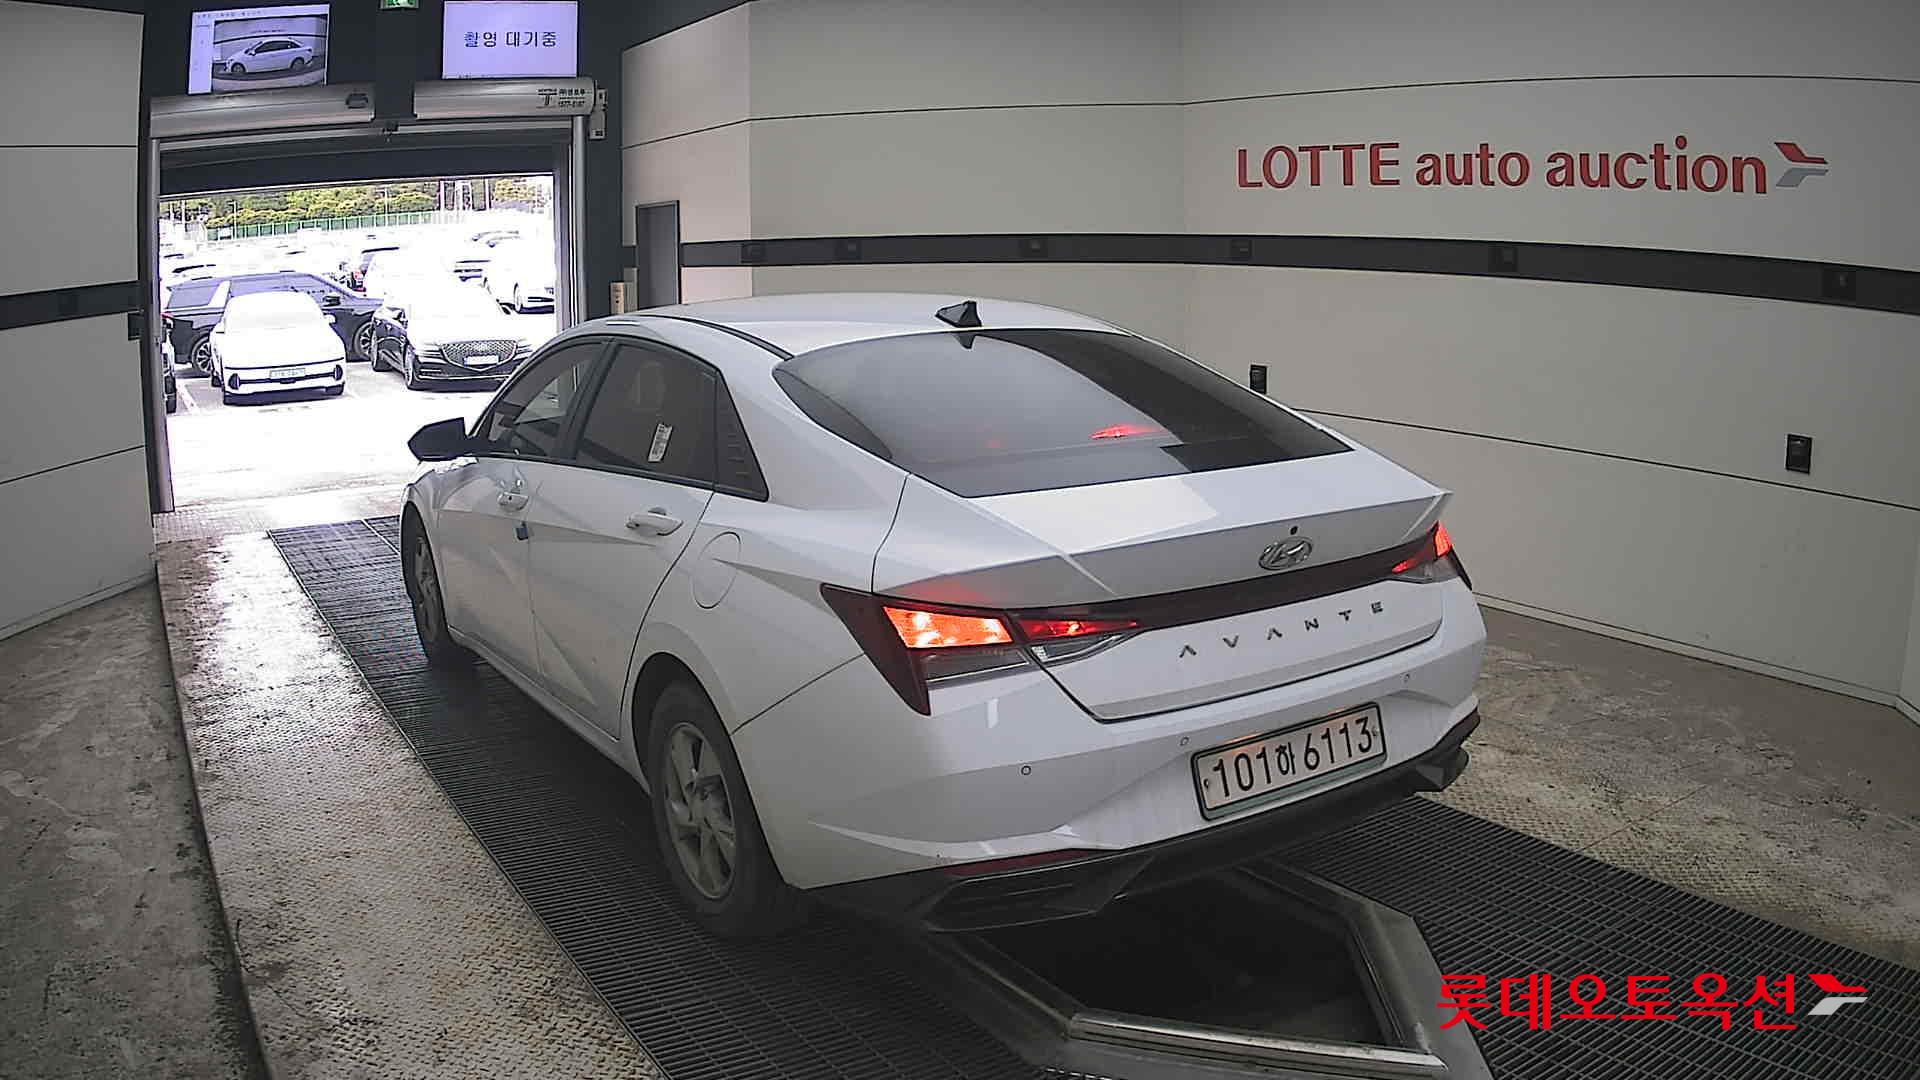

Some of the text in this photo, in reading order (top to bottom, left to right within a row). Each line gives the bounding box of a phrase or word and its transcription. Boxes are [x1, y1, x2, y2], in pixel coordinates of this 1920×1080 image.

[506, 31, 557, 48] 대기중
[1237, 135, 1767, 195] LOTTE auto auction
[1179, 601, 1384, 659] AVANTE
